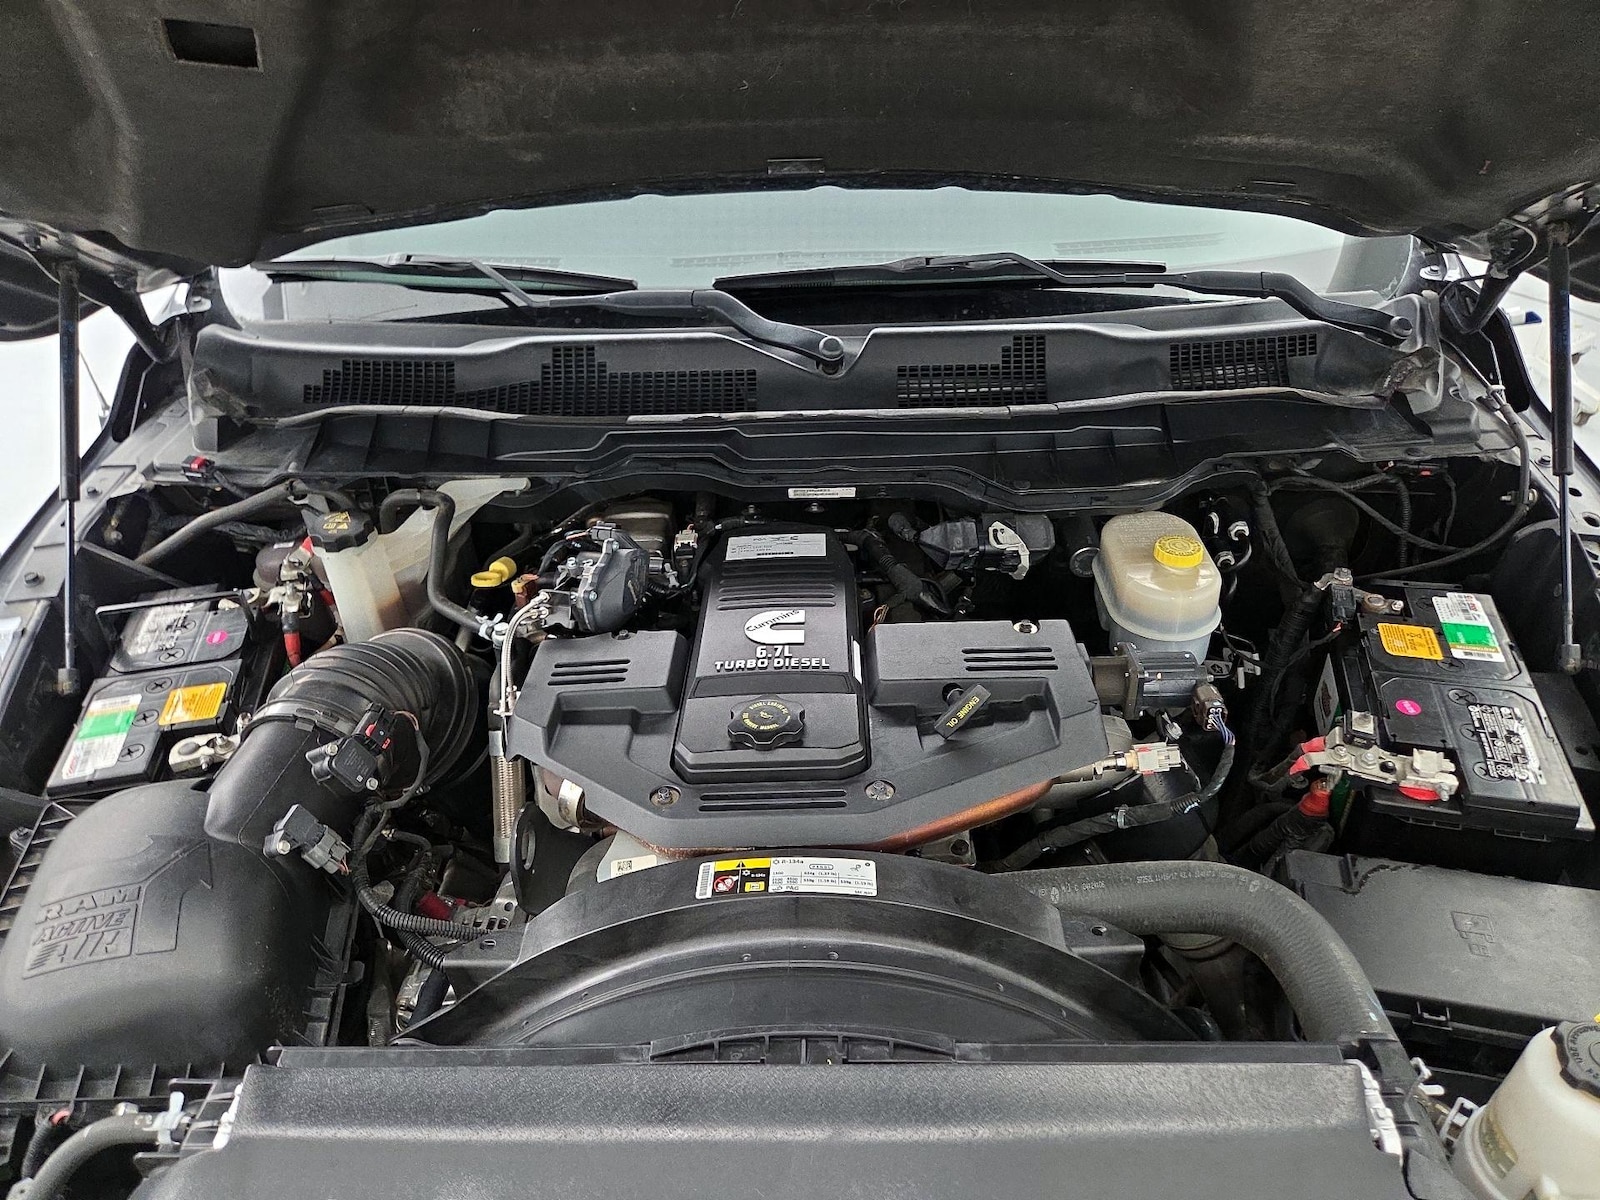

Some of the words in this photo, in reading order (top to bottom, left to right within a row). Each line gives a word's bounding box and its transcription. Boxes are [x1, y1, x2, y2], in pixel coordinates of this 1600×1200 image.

[745, 609, 800, 632] Cummins
[756, 645, 793, 659] 6.7L
[714, 659, 768, 671] TURBO
[773, 657, 830, 670] DIESEL
[956, 695, 980, 719] ENGINE
[945, 717, 959, 728] OIL
[36, 886, 141, 925] RAM
[33, 909, 131, 945] ACTIVE
